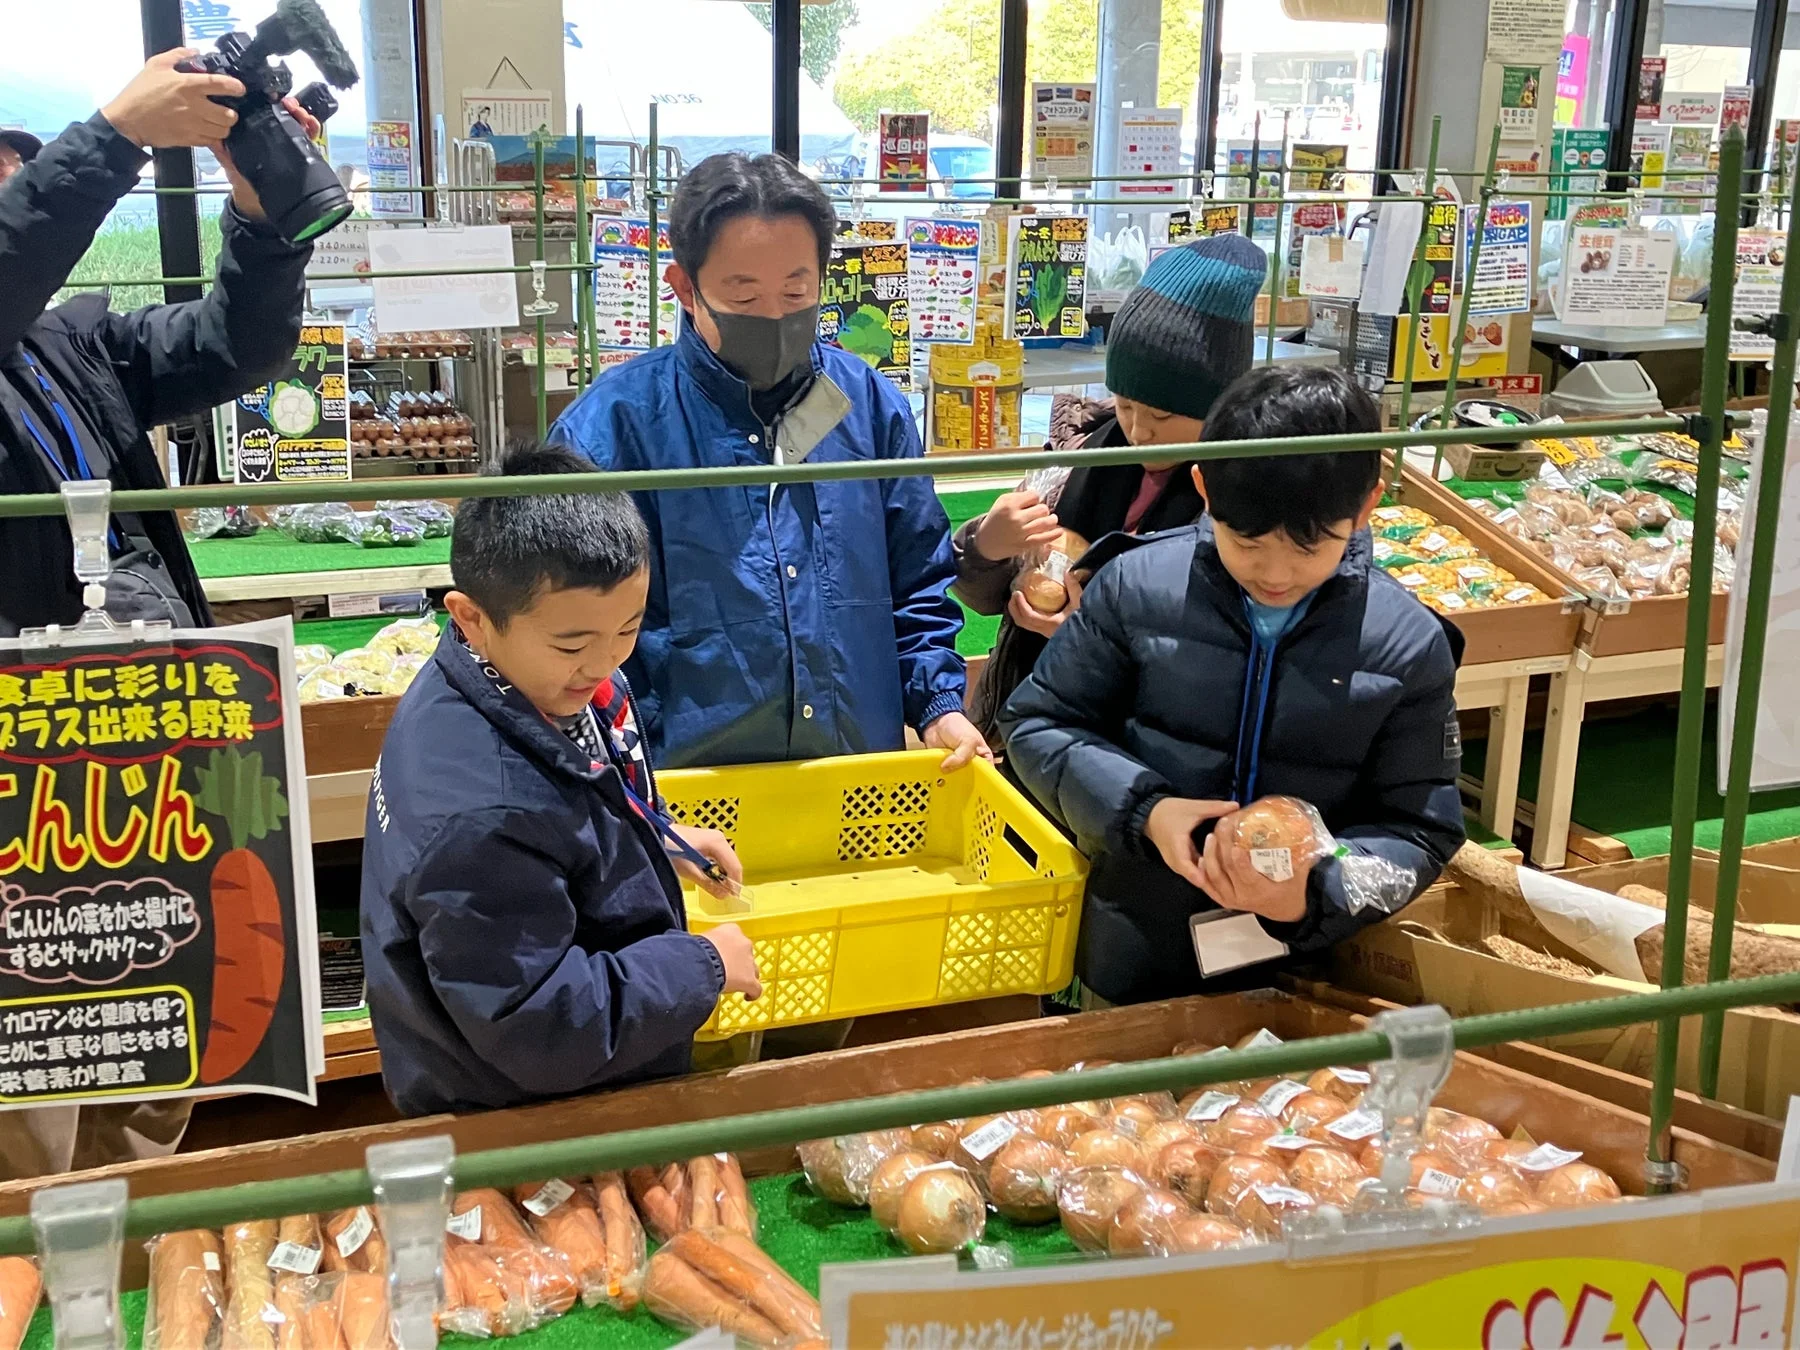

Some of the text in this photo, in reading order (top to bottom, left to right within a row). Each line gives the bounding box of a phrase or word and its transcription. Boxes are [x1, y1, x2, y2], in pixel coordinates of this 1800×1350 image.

[1044, 106, 1084, 114] フォトコンテスト
[1667, 104, 1716, 114] インフォメーション
[882, 137, 926, 154] 巡回中
[1579, 234, 1615, 249] 生椎茸
[1493, 378, 1536, 390] 消火器
[6, 896, 195, 940] にんじんの葉をかき揚げに
[0, 997, 187, 1035] カロテンなど健康を保つ
